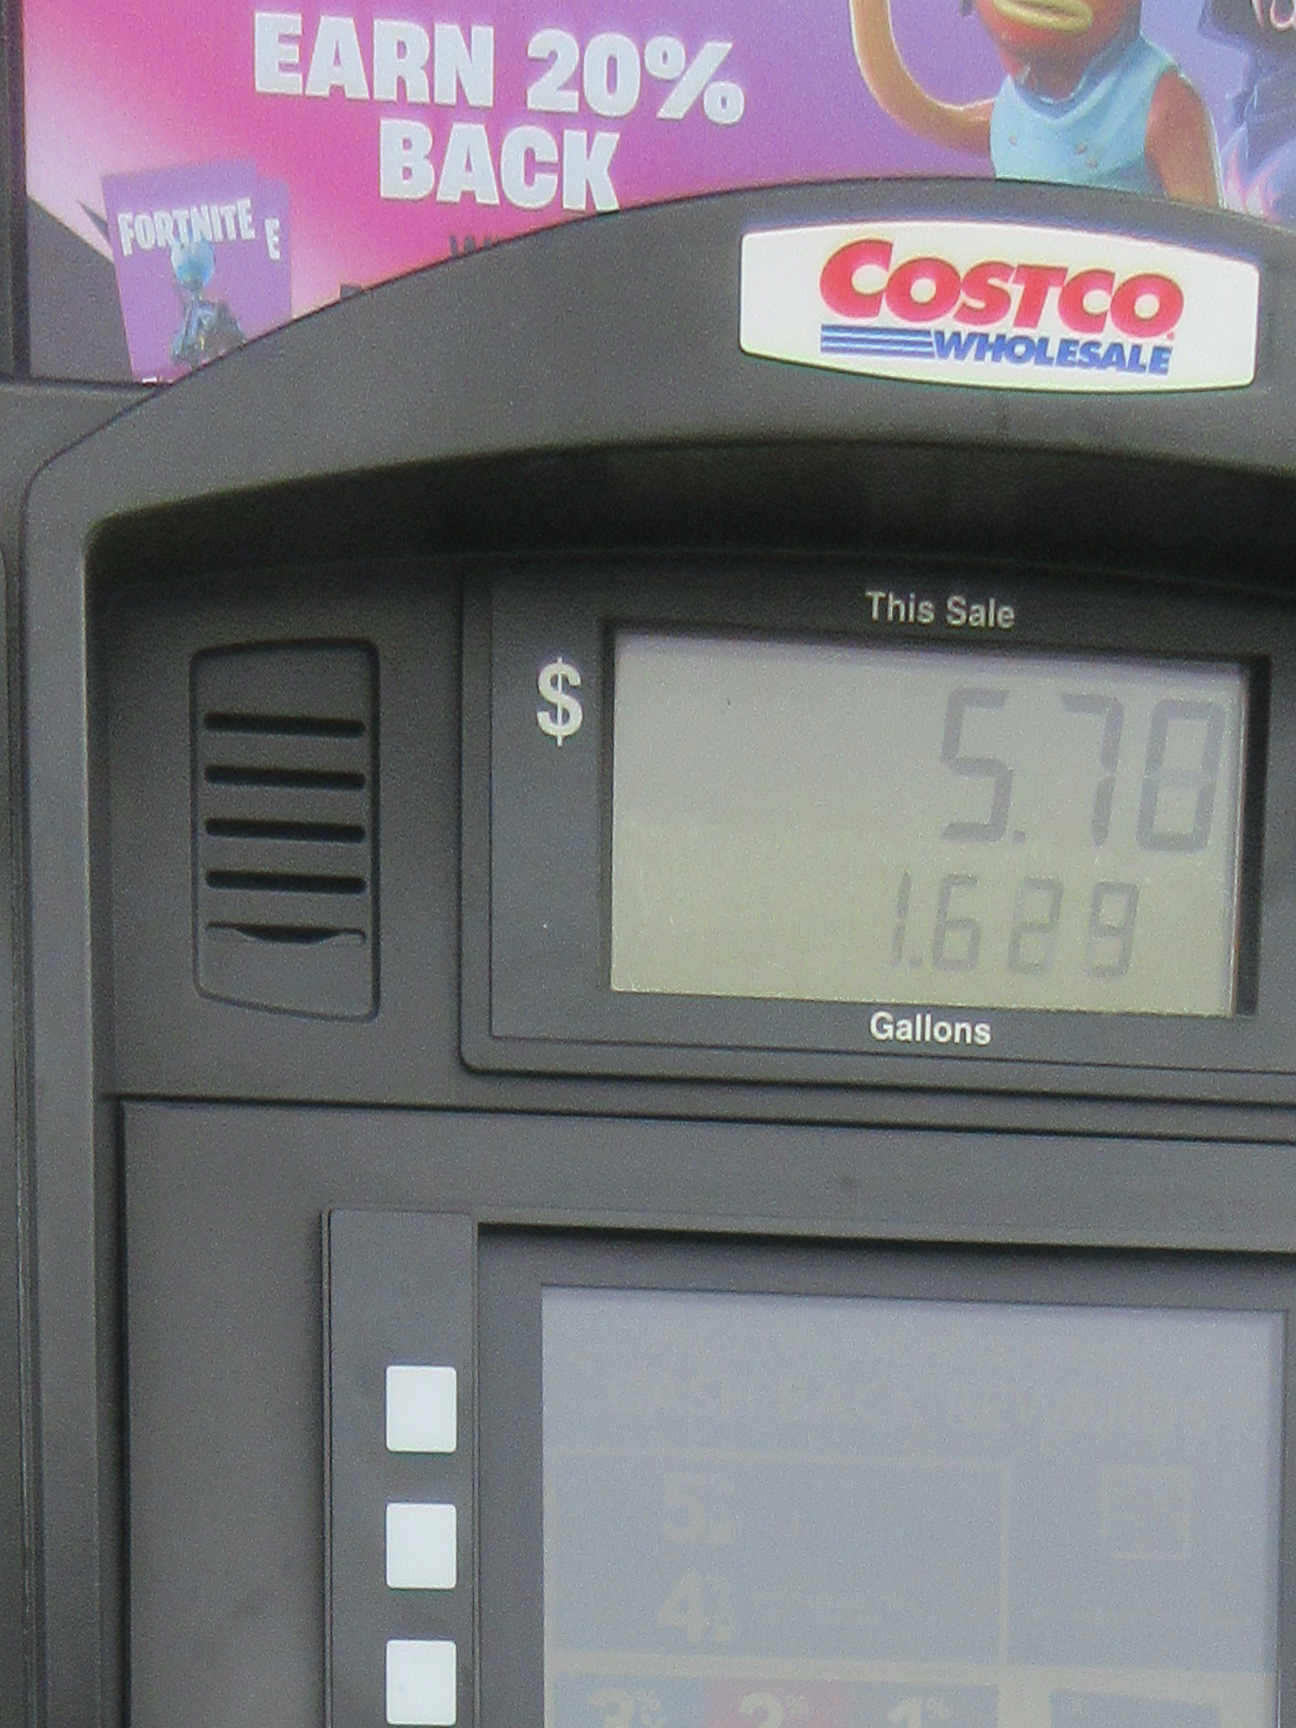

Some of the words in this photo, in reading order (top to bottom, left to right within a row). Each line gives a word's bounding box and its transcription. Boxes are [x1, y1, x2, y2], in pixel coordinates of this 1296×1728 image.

[253, 11, 495, 106] EARN
[524, 27, 746, 127] 20%
[378, 117, 620, 211] BACK
[116, 197, 256, 257] FORTNITE
[819, 239, 1184, 339] COSTCO
[930, 329, 1173, 375] WHOLESALE
[865, 590, 935, 624] This
[946, 594, 1016, 629] Sale
[536, 657, 583, 747] $
[870, 1010, 992, 1045] Gallons
